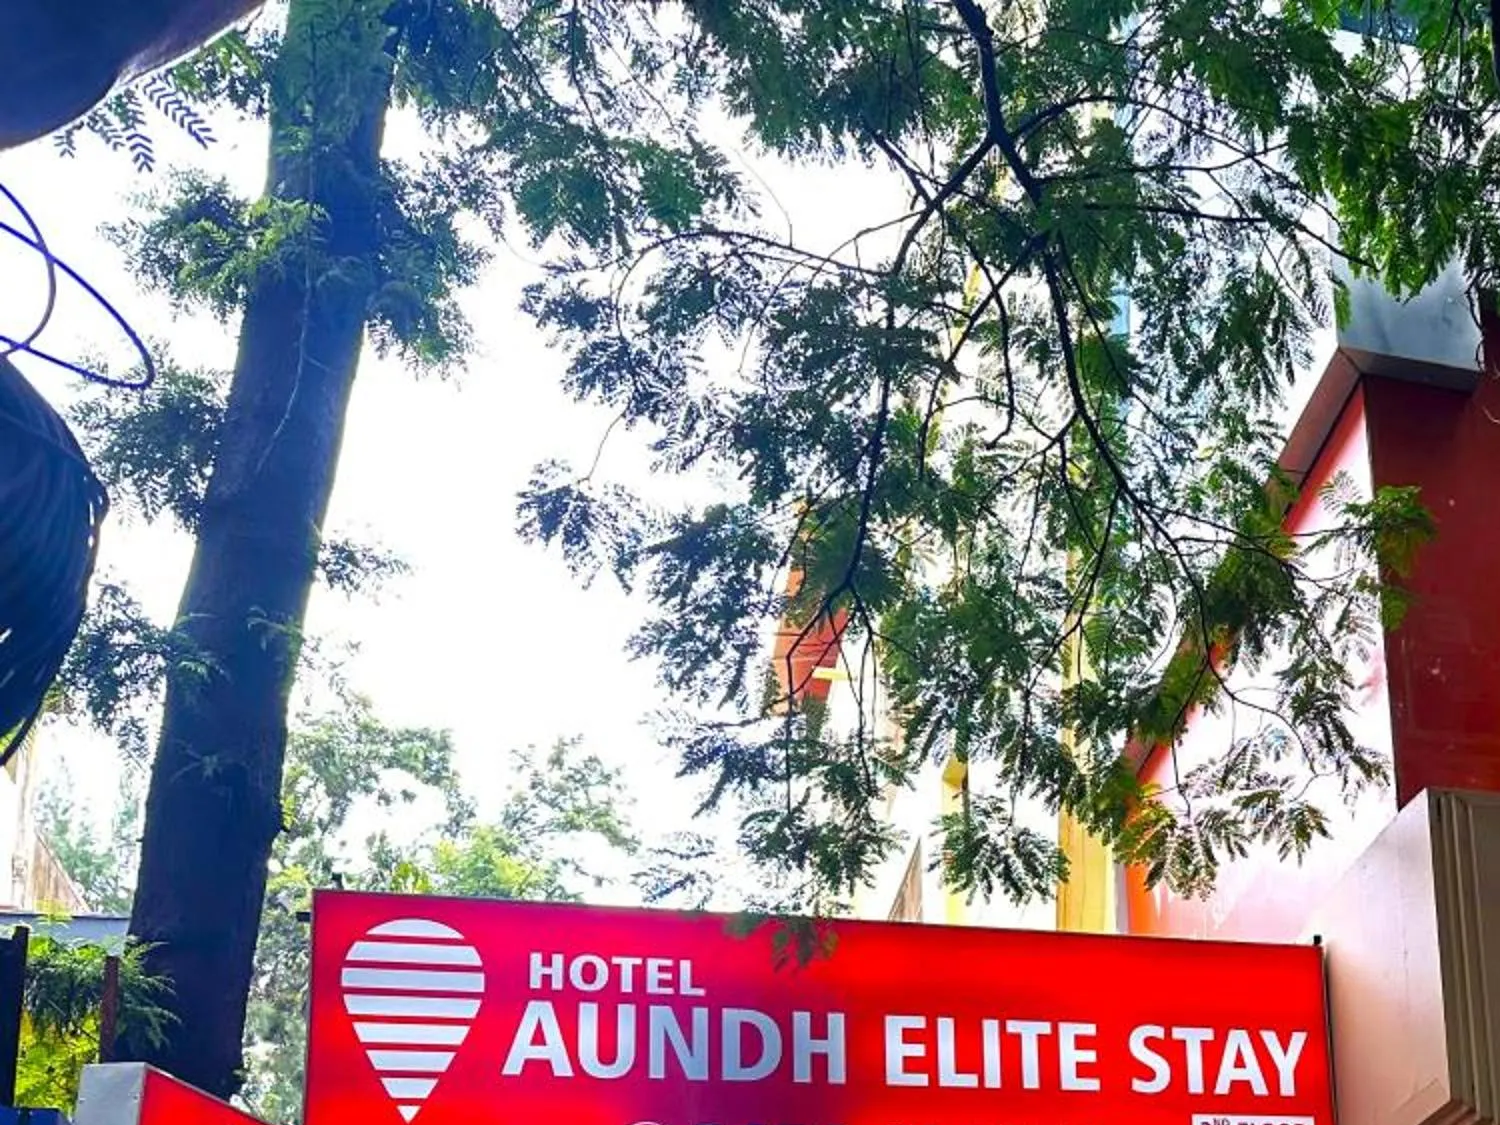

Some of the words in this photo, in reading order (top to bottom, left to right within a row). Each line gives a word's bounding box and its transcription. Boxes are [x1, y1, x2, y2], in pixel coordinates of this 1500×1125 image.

[529, 951, 706, 998] HOTEL
[501, 1001, 847, 1086] AUNDH
[884, 1014, 1101, 1093] ELITE
[1128, 1023, 1309, 1099] STAY
